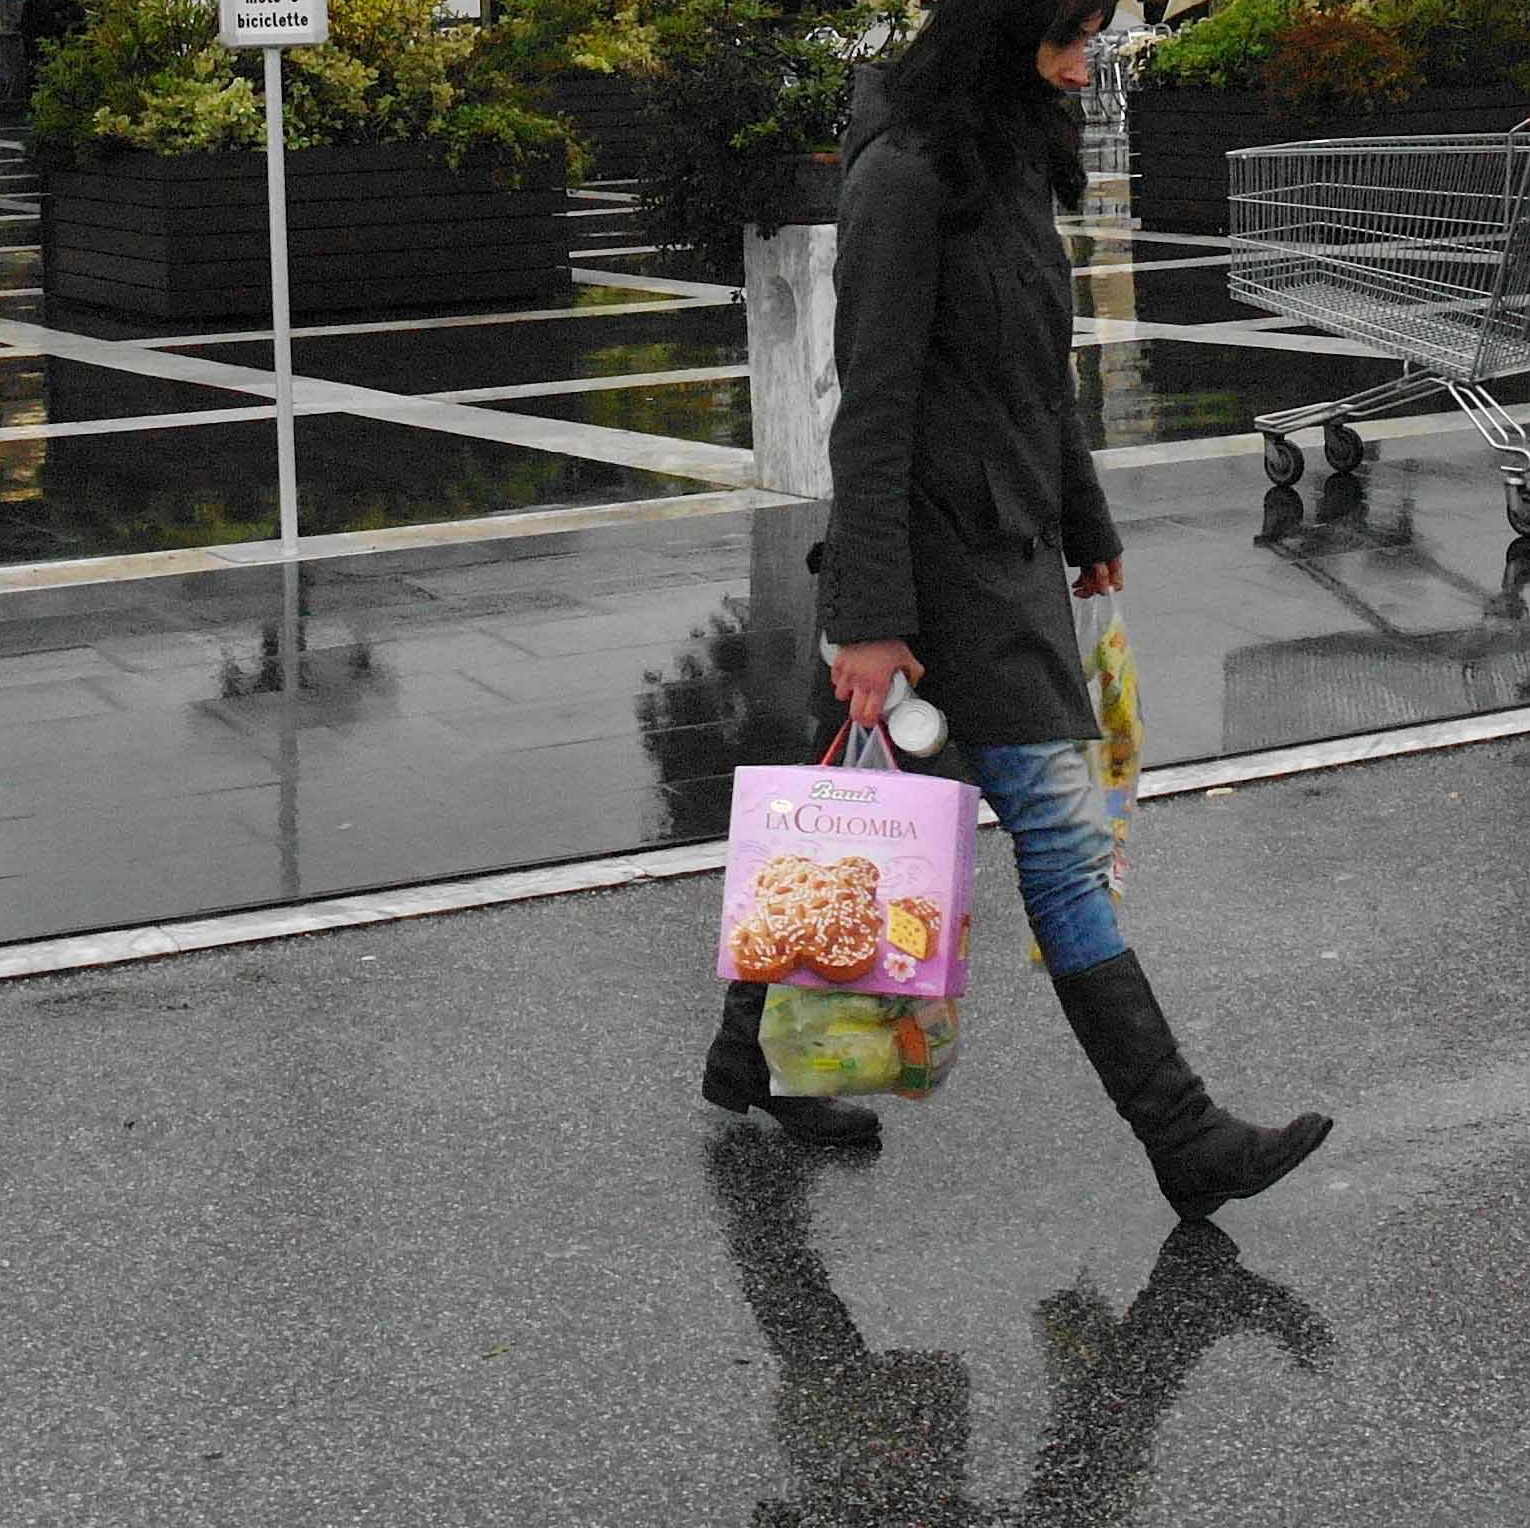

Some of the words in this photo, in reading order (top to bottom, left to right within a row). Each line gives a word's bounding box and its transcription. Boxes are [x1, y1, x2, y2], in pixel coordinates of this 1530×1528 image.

[237, 12, 309, 29] biciclette
[809, 779, 880, 804] Bauli
[765, 812, 790, 831] LA
